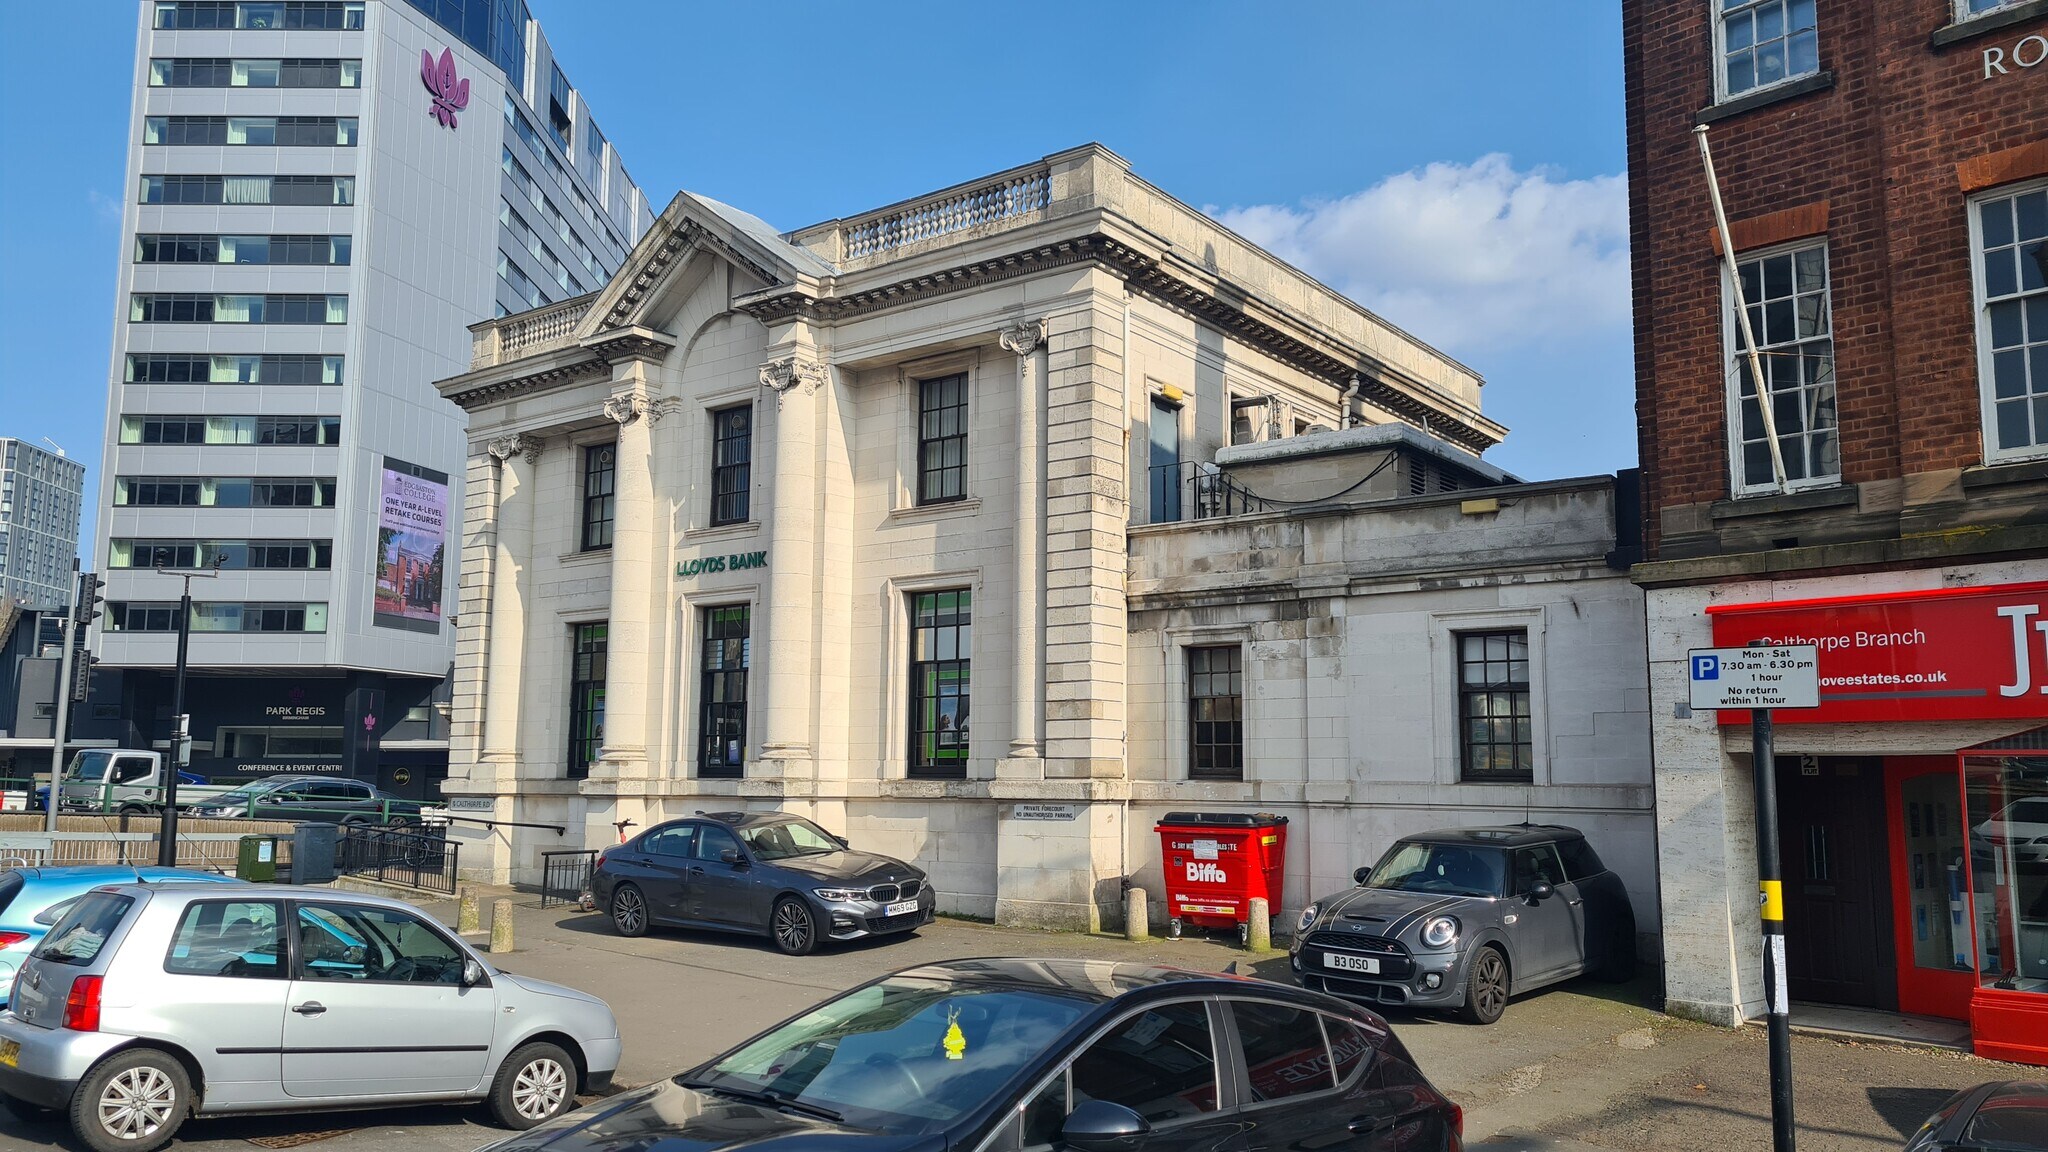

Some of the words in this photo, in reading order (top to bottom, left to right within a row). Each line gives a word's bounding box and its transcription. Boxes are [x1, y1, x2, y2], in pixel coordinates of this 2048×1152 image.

[404, 481, 436, 495] EDGBASTON
[404, 488, 436, 503] COLLEGE
[385, 496, 399, 506] ONE
[401, 500, 417, 511] YEAR
[417, 505, 443, 517] A-LEVEL
[385, 506, 411, 519] RETAKE
[412, 513, 442, 527] COURSES
[676, 556, 725, 577] LLOYDS
[729, 551, 768, 571] BANK
[1855, 629, 1926, 648] Branch
[1742, 651, 1764, 659] Mon
[1772, 649, 1791, 658] Sat
[1721, 662, 1745, 671] 7.30
[1769, 660, 1795, 669] 6.30
[1797, 660, 1813, 670] pm
[1759, 673, 1783, 681] hour
[1818, 670, 1947, 687] oveestates.co.uk
[1728, 687, 1742, 695] No
[1745, 686, 1778, 695] return
[1720, 696, 1752, 705] within
[1762, 696, 1787, 704] hour
[266, 706, 292, 715] PARK
[296, 706, 326, 716] REGIS
[1186, 862, 1227, 883] Biffa
[1334, 956, 1346, 968] B3
